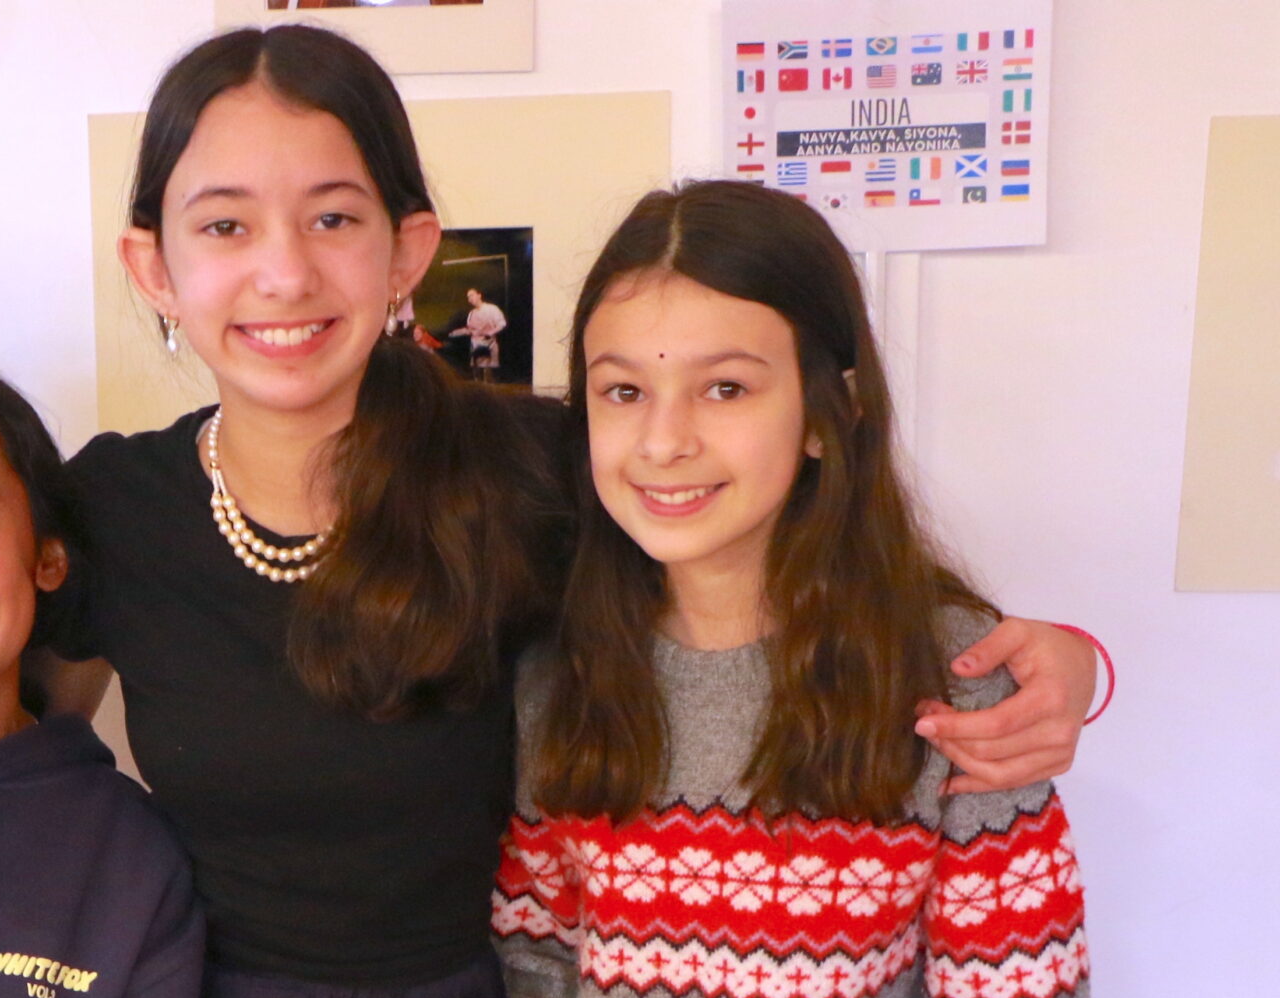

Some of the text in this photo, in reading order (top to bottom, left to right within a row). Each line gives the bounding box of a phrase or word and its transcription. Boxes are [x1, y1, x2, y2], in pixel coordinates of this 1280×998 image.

[850, 97, 912, 127] INDIA
[904, 126, 963, 139] SIYONA,
[795, 139, 961, 156] AANYA, AND NAYONIKA
